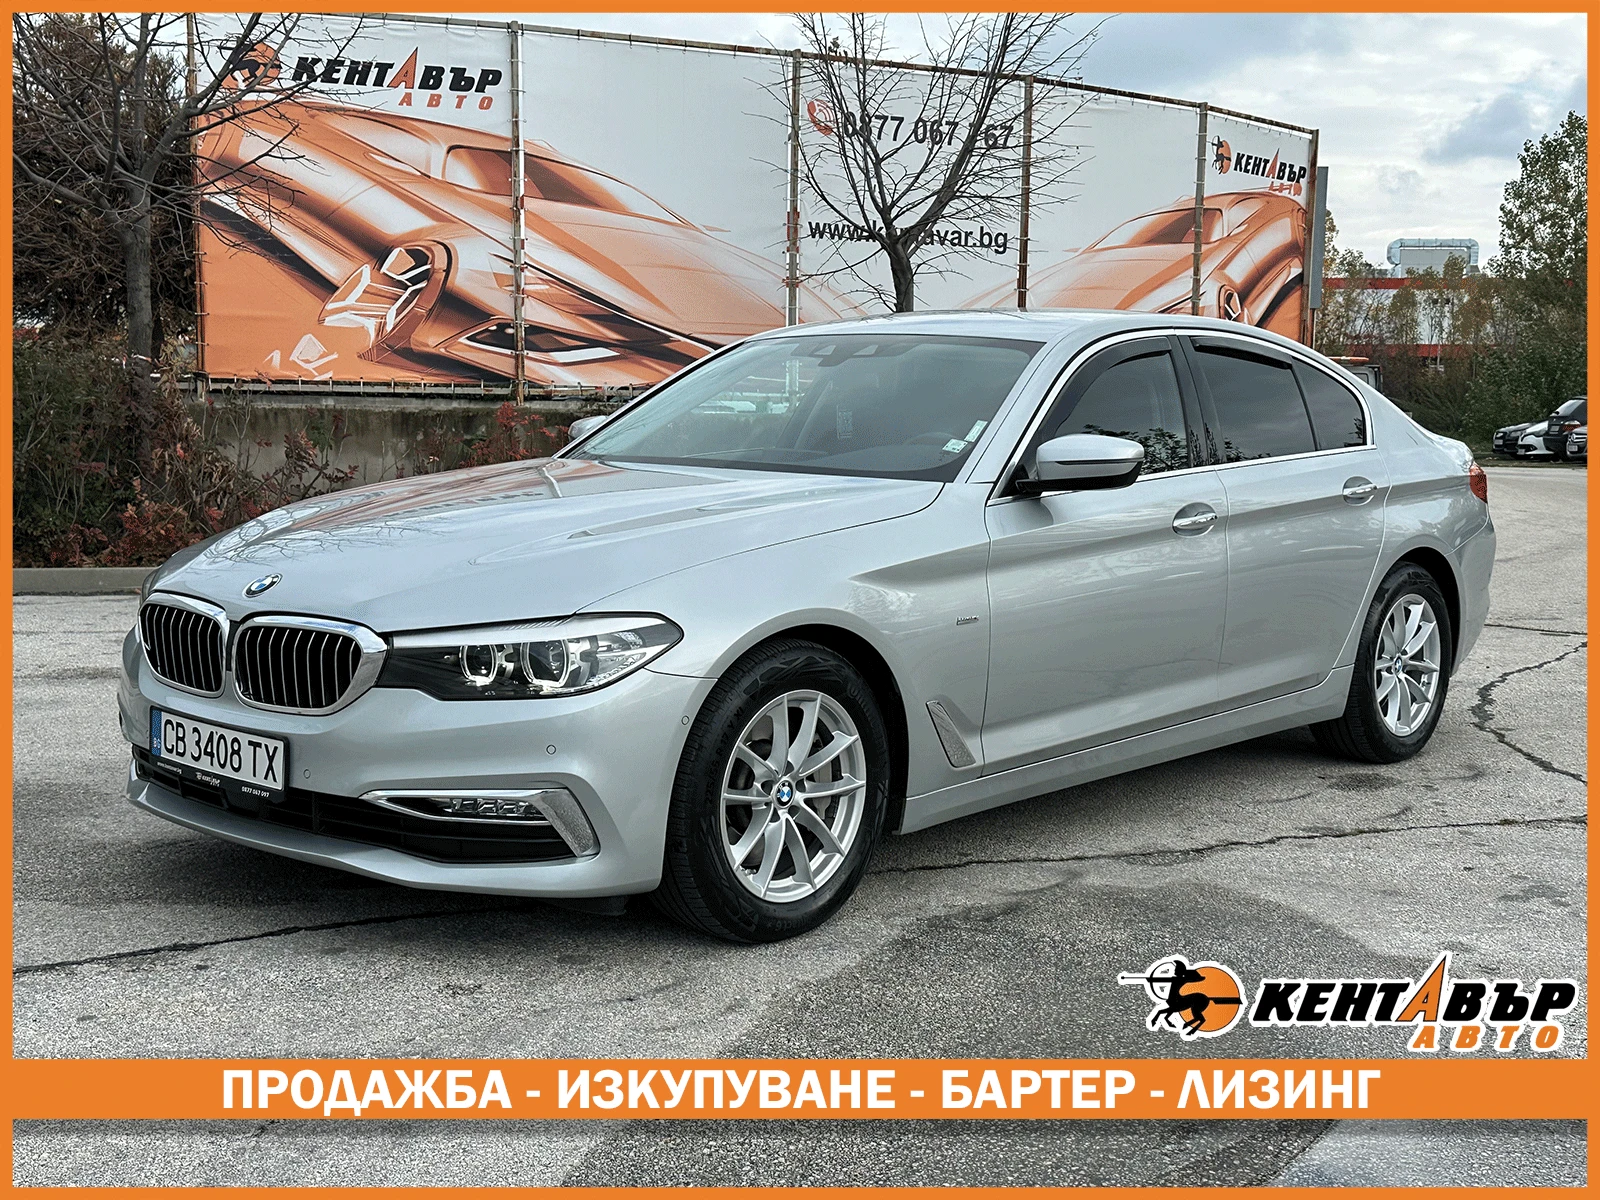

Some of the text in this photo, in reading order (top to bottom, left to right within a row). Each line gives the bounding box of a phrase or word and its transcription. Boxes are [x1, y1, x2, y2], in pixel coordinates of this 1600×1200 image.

[292, 46, 503, 94] КЕНТАВЪР
[399, 91, 494, 110] АВТО
[843, 111, 1014, 149] 0877 067 67
[1234, 148, 1307, 183] КЕНТАВЪР
[163, 718, 279, 783] CB 3408 TX
